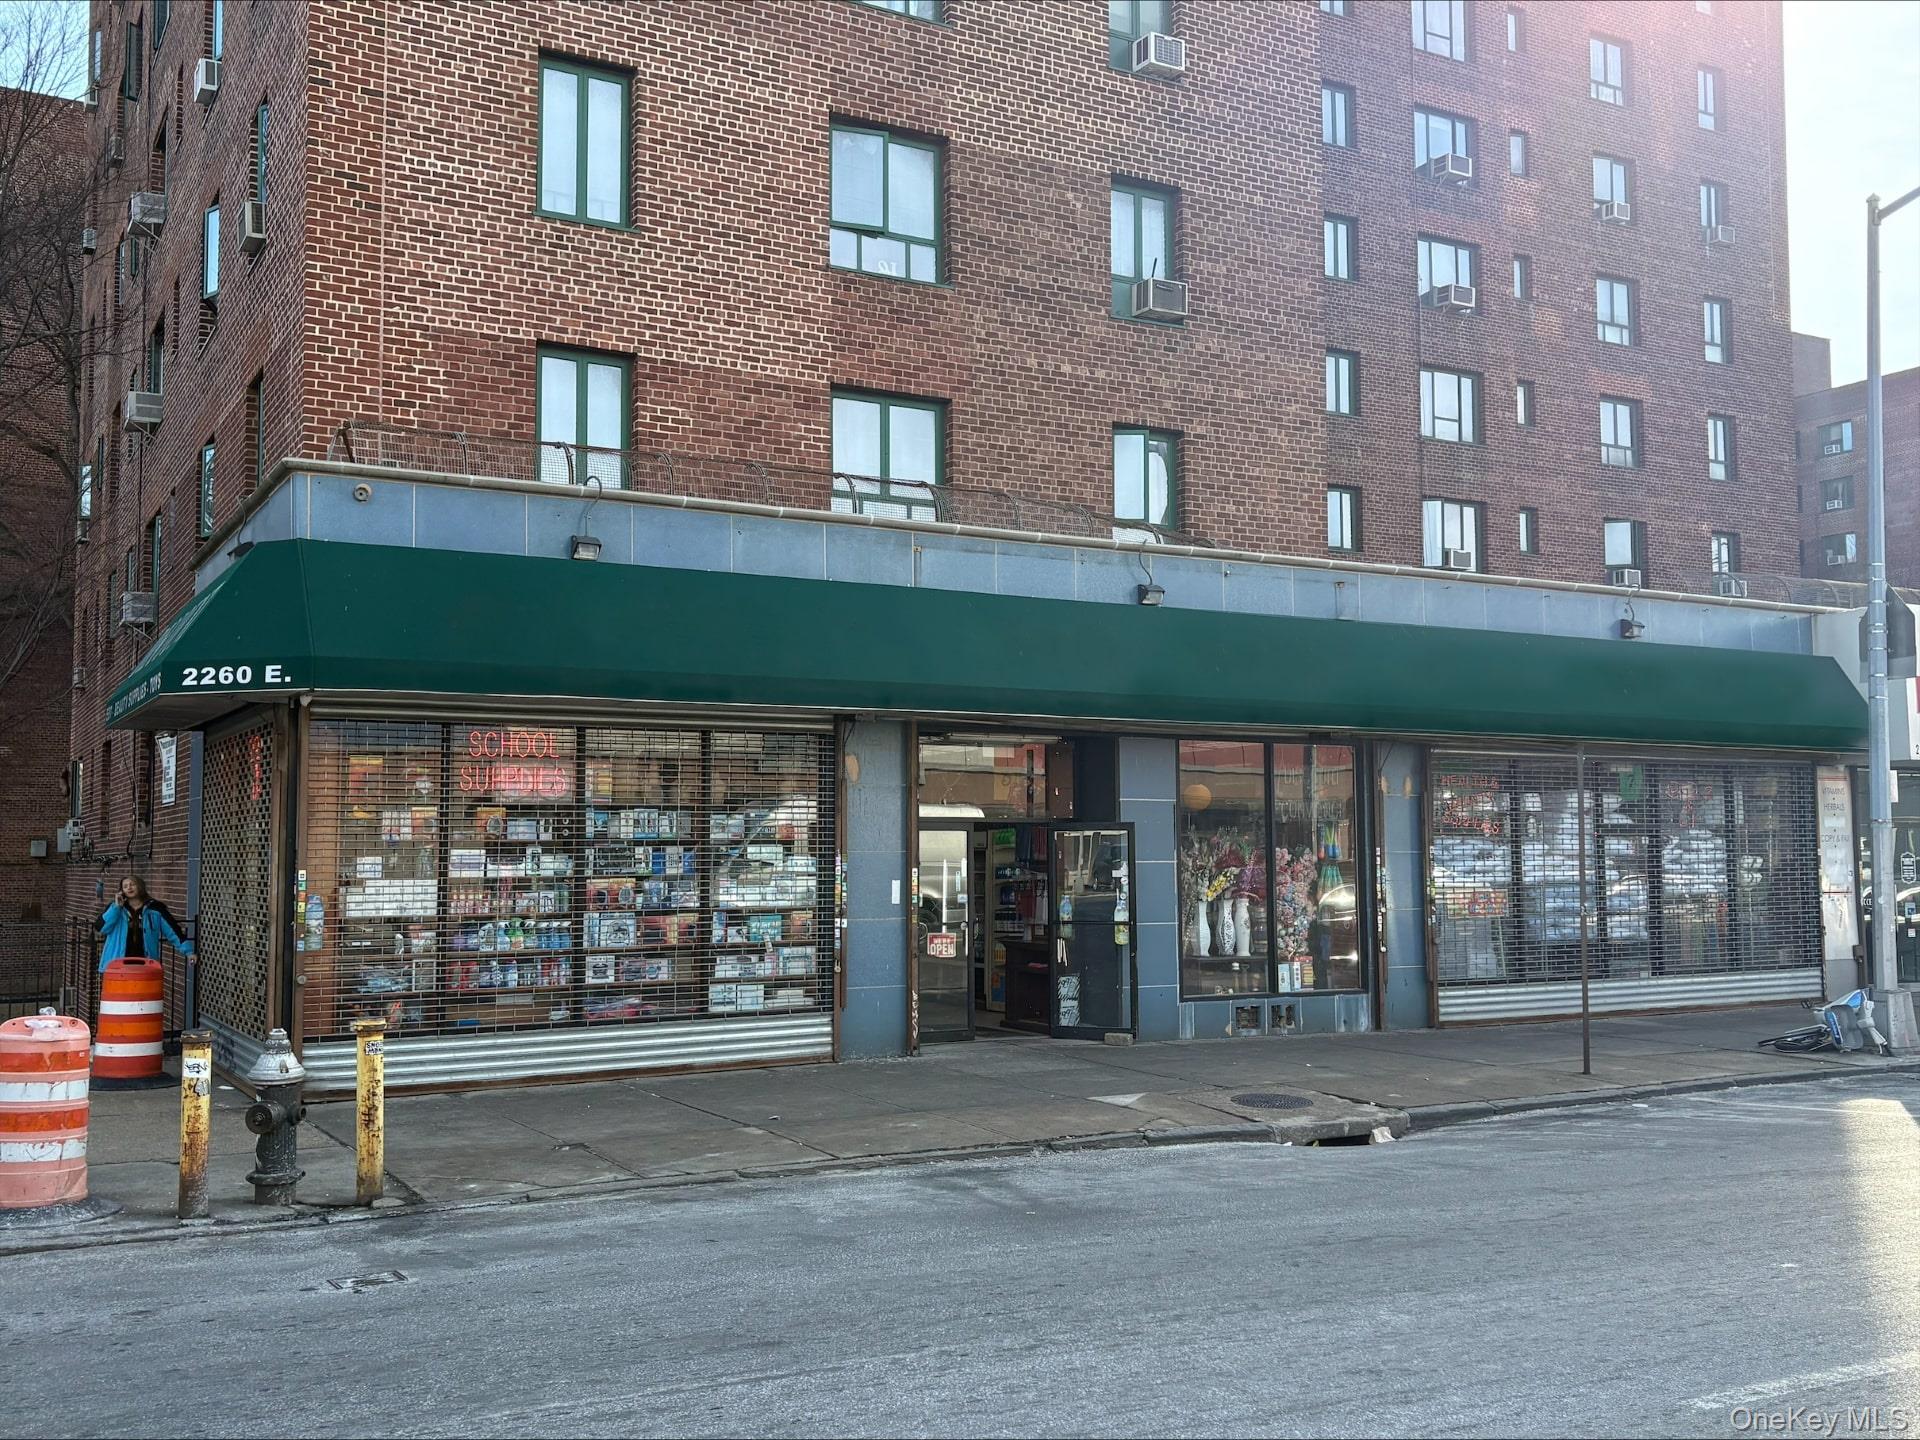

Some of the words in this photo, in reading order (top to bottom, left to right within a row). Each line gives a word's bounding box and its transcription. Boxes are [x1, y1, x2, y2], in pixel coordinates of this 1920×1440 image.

[182, 665, 252, 686] 2260
[265, 665, 291, 683] E.
[469, 731, 560, 758] SCHOOL
[460, 765, 566, 793] SUPPLIES
[930, 943, 954, 955] OPEN
